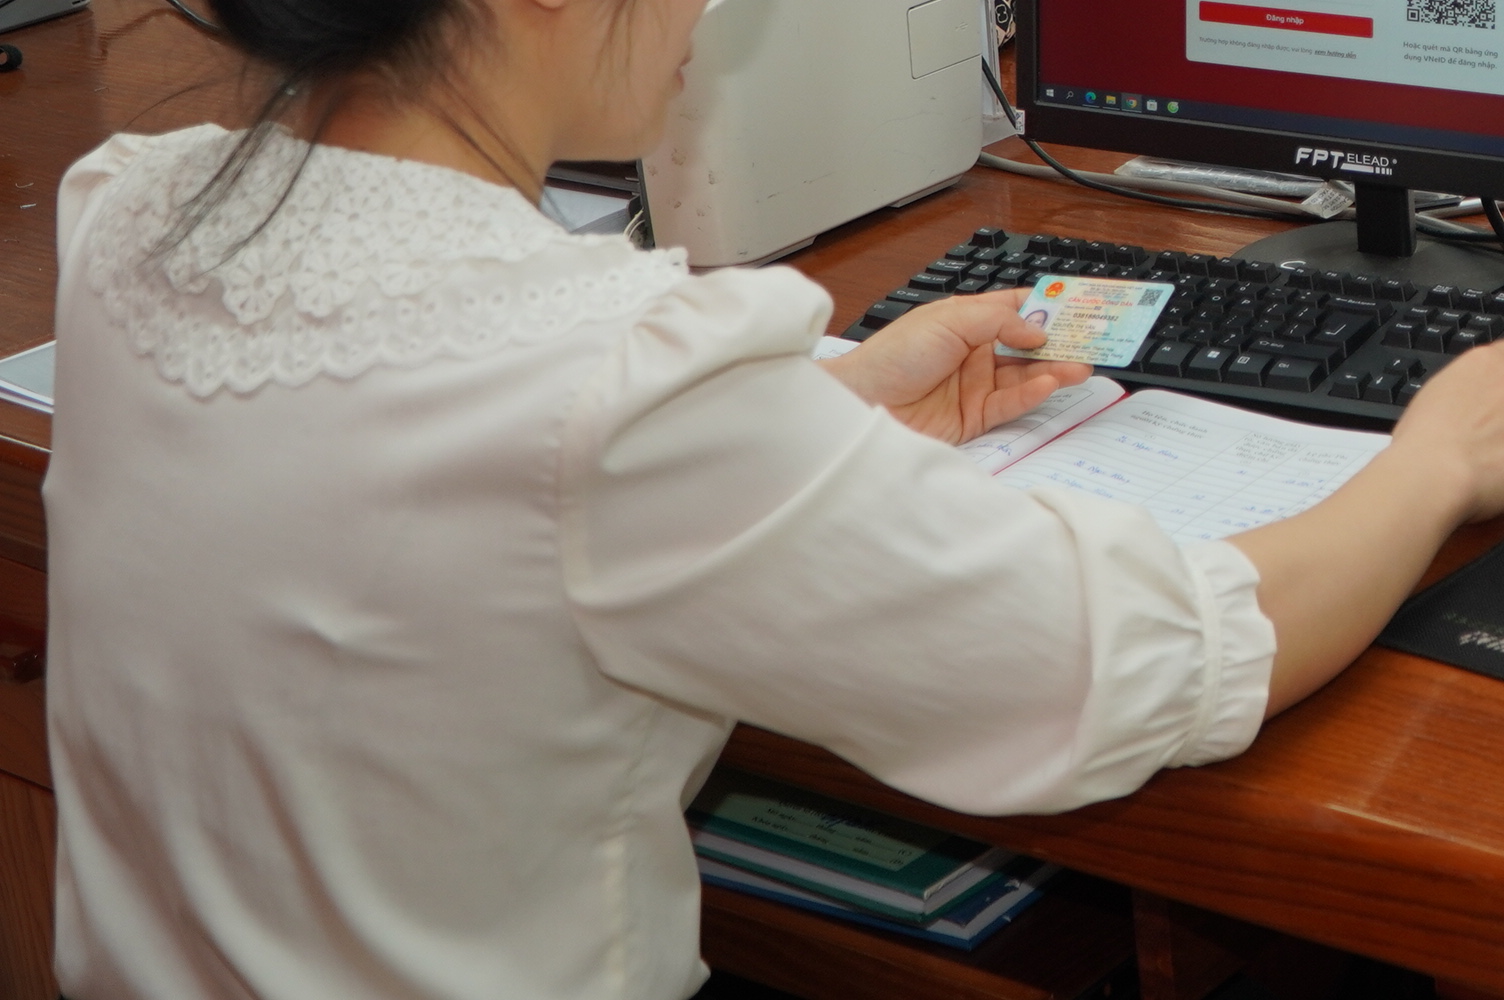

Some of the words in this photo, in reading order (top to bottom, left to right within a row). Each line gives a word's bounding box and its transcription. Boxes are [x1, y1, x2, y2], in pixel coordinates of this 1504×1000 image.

[1266, 13, 1285, 24] Đăng
[1286, 15, 1304, 26] nhập
[1403, 41, 1421, 50] Hoặc
[1422, 43, 1438, 52] quét
[1465, 47, 1482, 57] bằng
[1484, 48, 1498, 58] ứng
[1403, 53, 1421, 63] dụng
[1423, 55, 1446, 63] VNeID
[1458, 58, 1476, 68] đăng
[1477, 60, 1497, 70] nhập.
[1295, 147, 1344, 169] FPT
[1347, 153, 1389, 167] ELEAD
